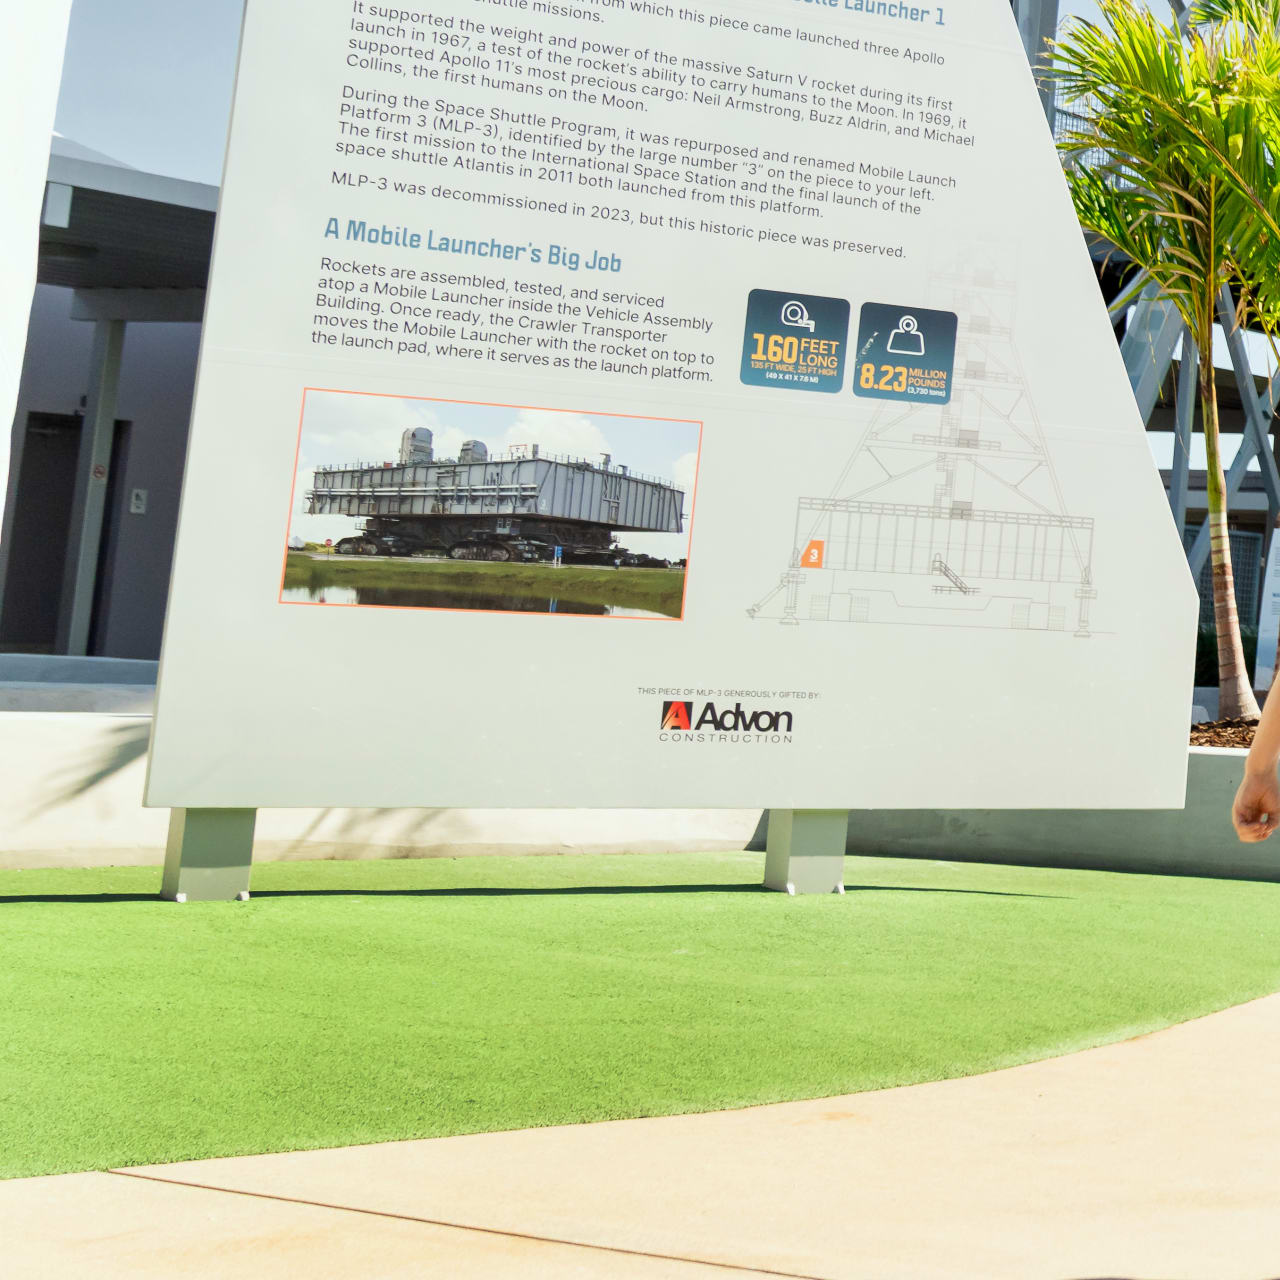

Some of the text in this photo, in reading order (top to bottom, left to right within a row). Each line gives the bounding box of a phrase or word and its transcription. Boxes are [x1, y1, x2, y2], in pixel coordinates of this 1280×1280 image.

[532, 1, 605, 23] missions.
[935, 7, 945, 26] 1
[630, 1, 674, 18] which
[678, 8, 705, 24] this
[709, 13, 749, 31] piece
[753, 23, 792, 39] came
[796, 28, 860, 51] launched
[863, 41, 900, 58] three
[903, 47, 945, 66] Apollo
[346, 52, 648, 112] Collins, the first humans on the Moon.
[335, 141, 824, 218] space shuttle Atlantis in 2011 both launched from this platform.
[331, 170, 907, 259] MLP-3 was decommissioned in 2023, but this historic piece was preserved.
[324, 219, 622, 273] A Mobile Launcher's Big Job
[320, 256, 665, 309] Rockets are assembled, tested, and serviced
[315, 293, 668, 343] Building. Once ready, the Crawler Transporter
[317, 277, 712, 334] atop a Mobile Launcher inside the Vehicle Assembly
[311, 330, 713, 382] the launch pad, where it serves as the launch platform.
[751, 332, 840, 364] 160 FEET
[799, 353, 838, 368] LONG
[751, 361, 764, 369] 135
[764, 362, 774, 370] FT
[775, 363, 796, 373] WIDE,
[818, 367, 837, 377] HIGH
[859, 362, 947, 393] 8.23 MILLION
[907, 377, 946, 389] POUNDS
[810, 548, 818, 560] 3
[638, 687, 657, 695] THIS
[658, 687, 681, 696] PIECE
[683, 688, 695, 696] OF
[696, 689, 722, 697] MLP-3
[724, 689, 776, 698] GENEROUSLY
[778, 691, 807, 699] GIFTED
[694, 702, 793, 732] Advon
[659, 733, 793, 743] CONSTRUCTION
